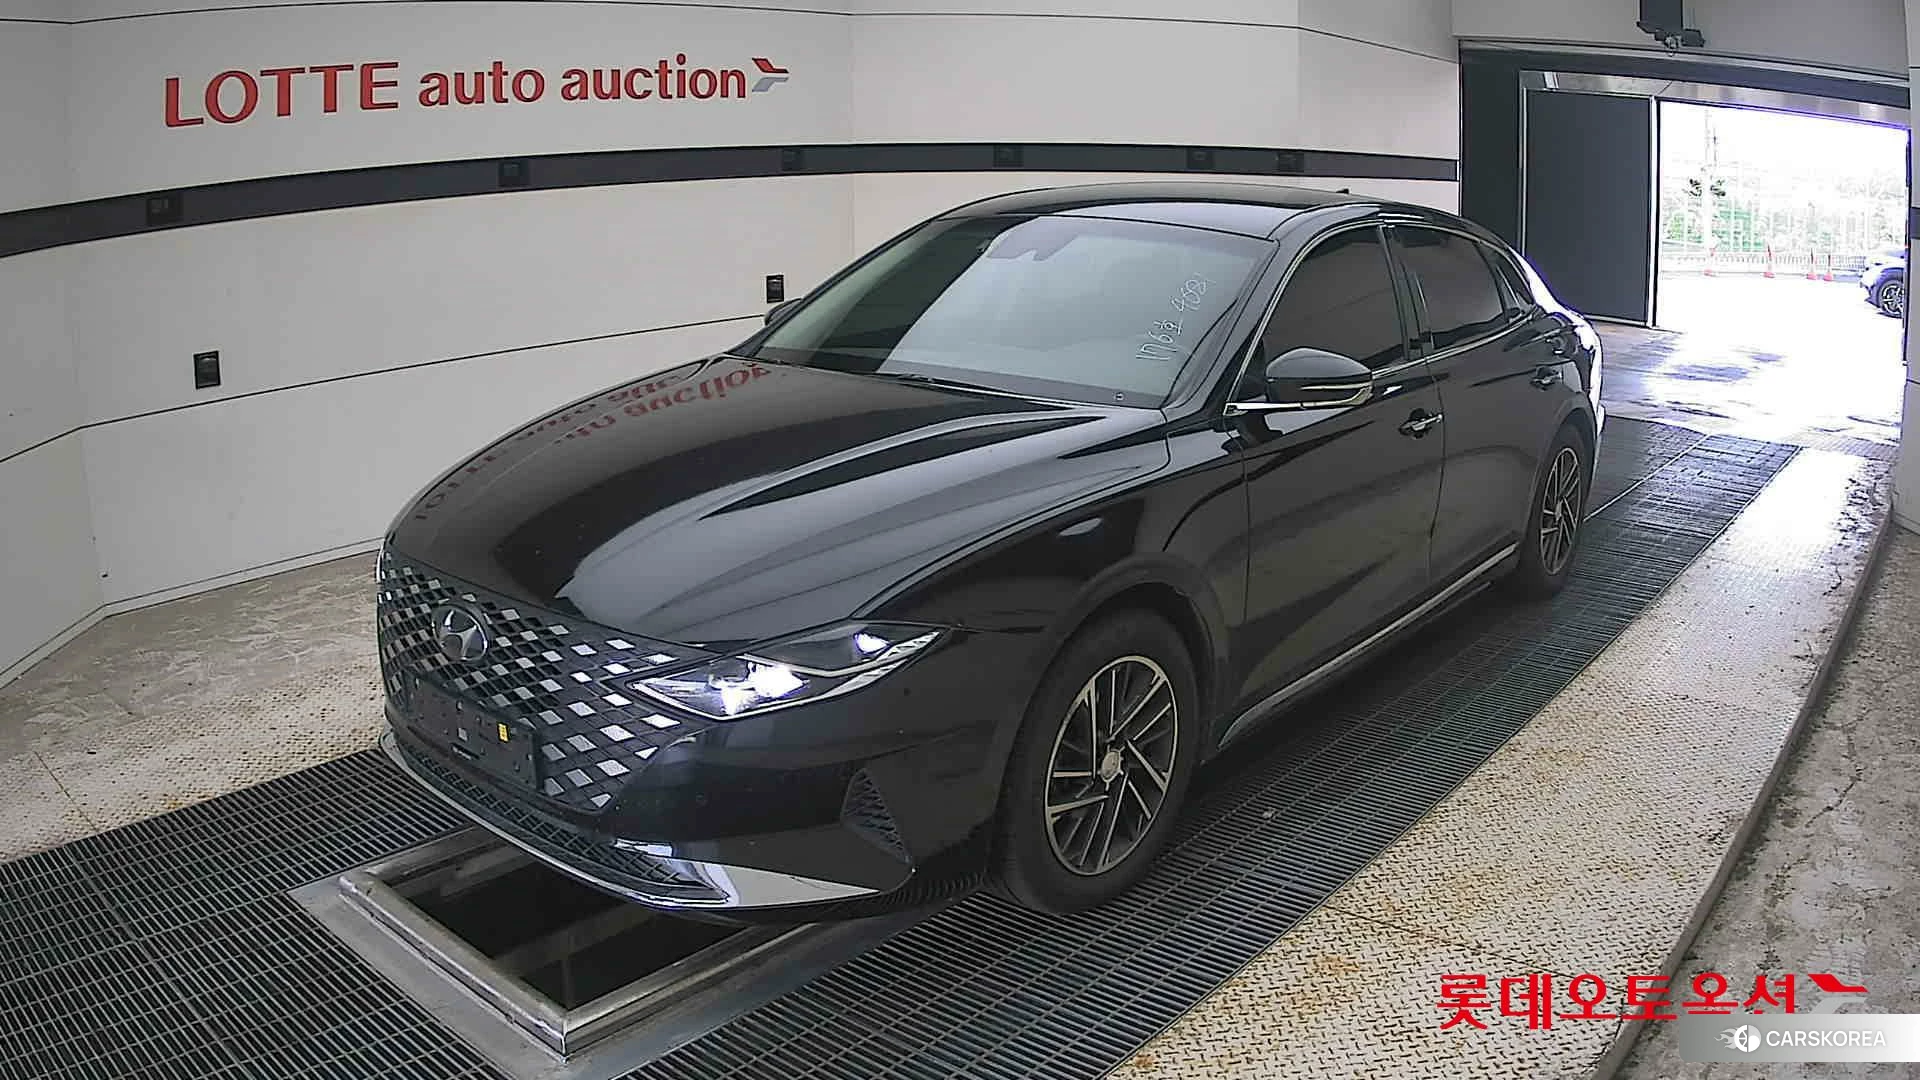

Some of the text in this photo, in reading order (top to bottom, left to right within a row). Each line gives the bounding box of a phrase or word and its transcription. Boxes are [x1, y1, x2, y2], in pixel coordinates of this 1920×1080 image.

[165, 53, 747, 128] LOTTE auto auction
